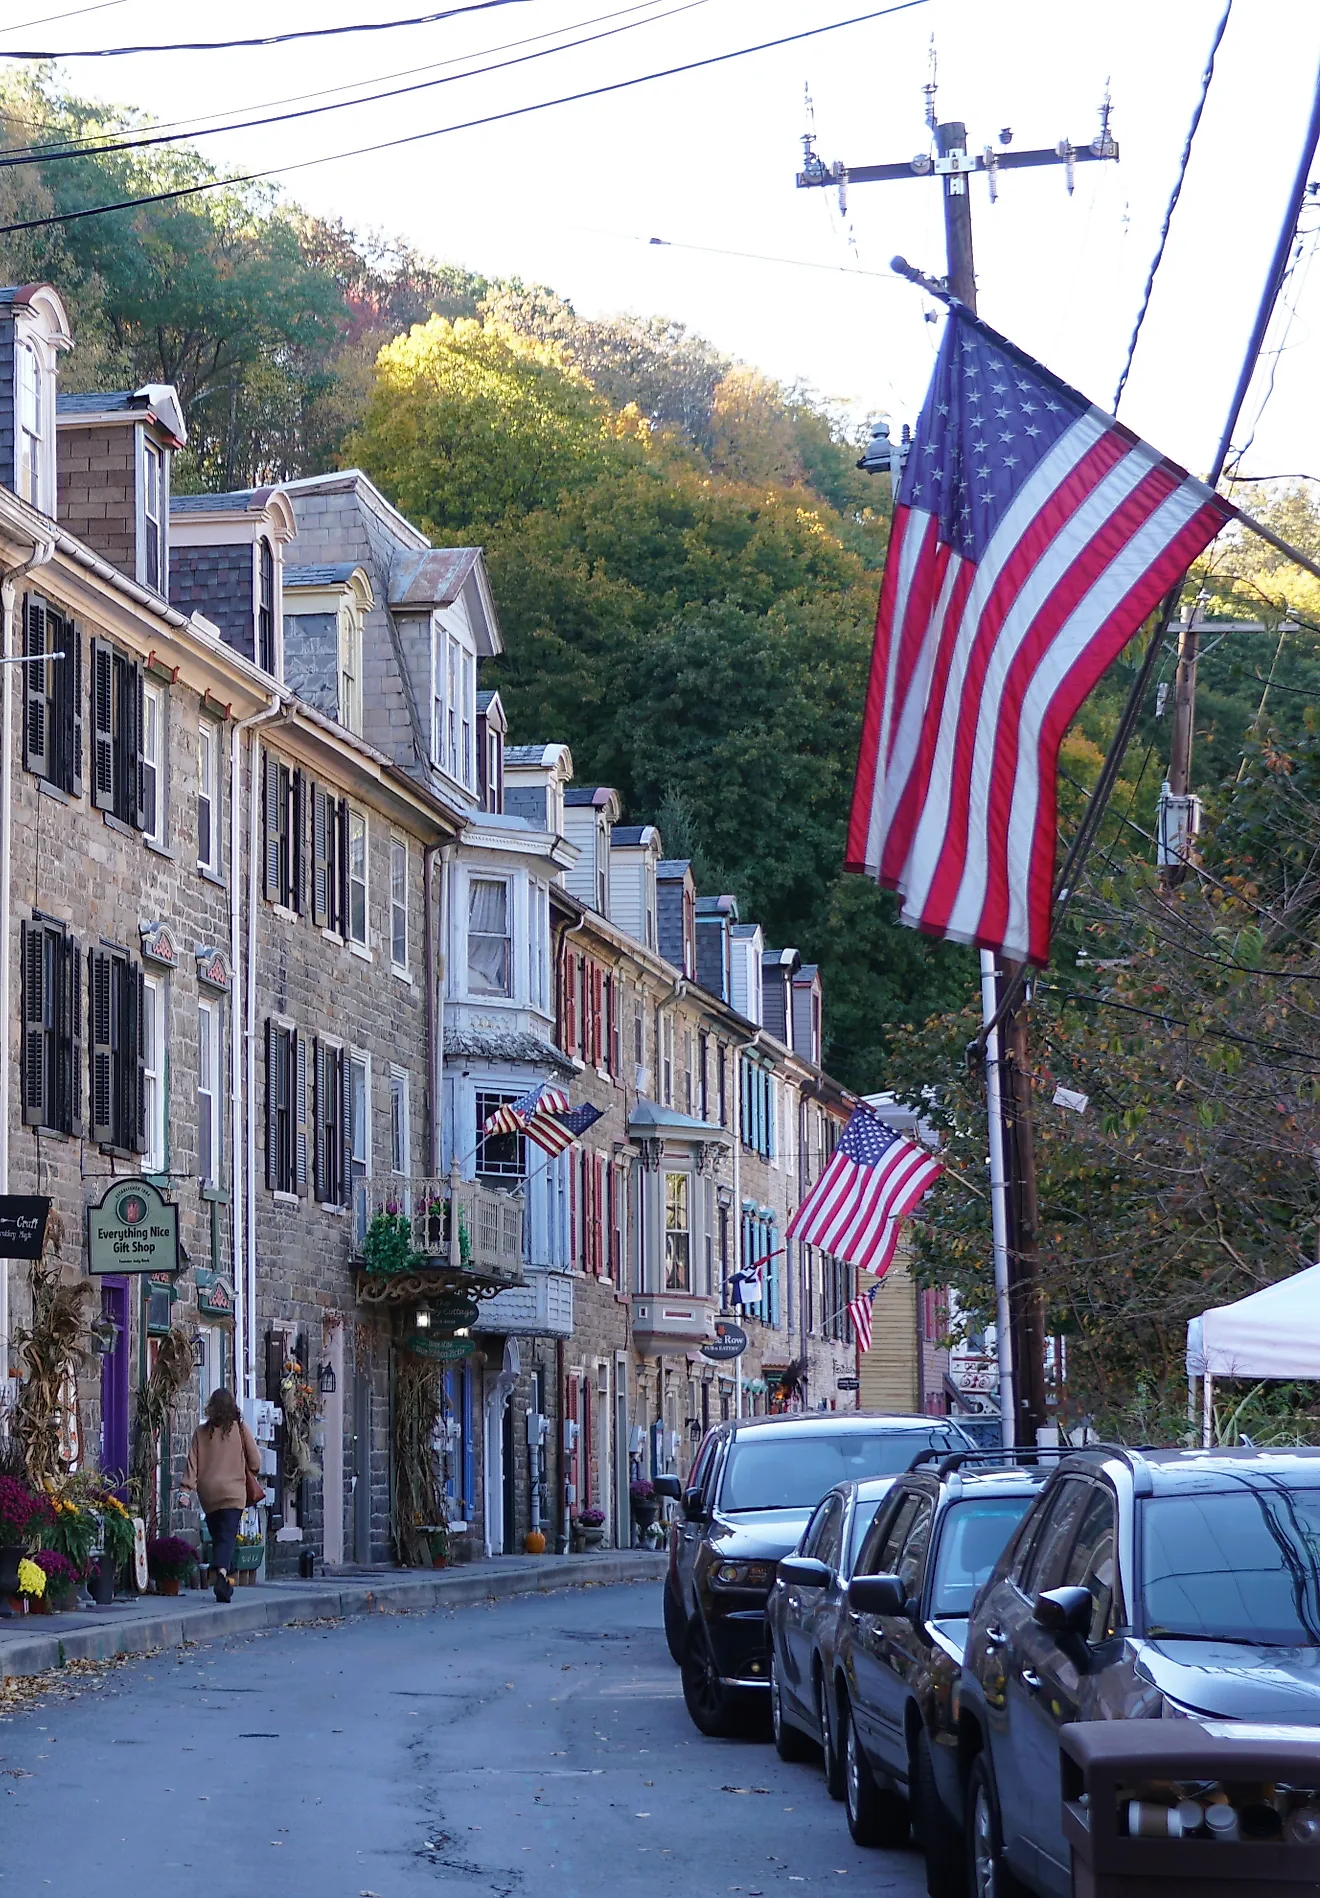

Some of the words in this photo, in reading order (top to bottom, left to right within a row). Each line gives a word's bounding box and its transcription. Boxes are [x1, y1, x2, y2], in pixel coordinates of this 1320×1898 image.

[16, 1215, 39, 1229] Craft
[98, 1227, 148, 1241] Everything
[150, 1226, 170, 1237] Nice
[113, 1242, 130, 1253] Gift
[132, 1241, 155, 1254] Shop
[444, 1308, 475, 1318] Cottage
